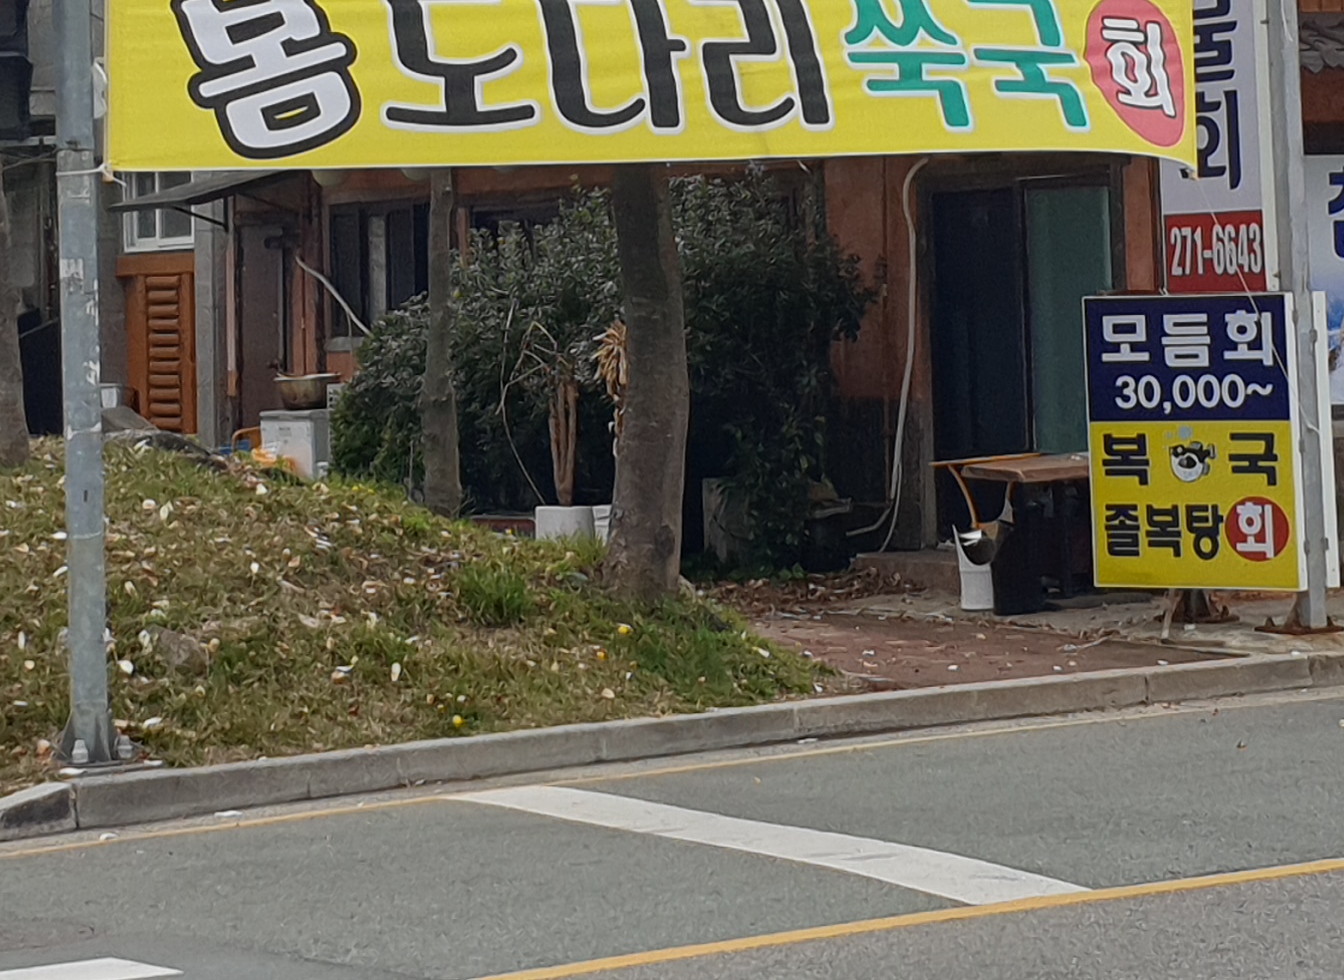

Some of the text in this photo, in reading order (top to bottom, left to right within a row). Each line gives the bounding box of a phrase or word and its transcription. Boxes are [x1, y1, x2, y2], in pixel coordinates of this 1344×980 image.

[1099, 13, 1180, 120] 회
[1170, 224, 1262, 278] 271-6643
[1100, 309, 1276, 369] 모듬회
[1112, 371, 1274, 416] 30,000~
[1101, 430, 1279, 488] 복 국
[1103, 501, 1278, 563] 졸복탕 회
